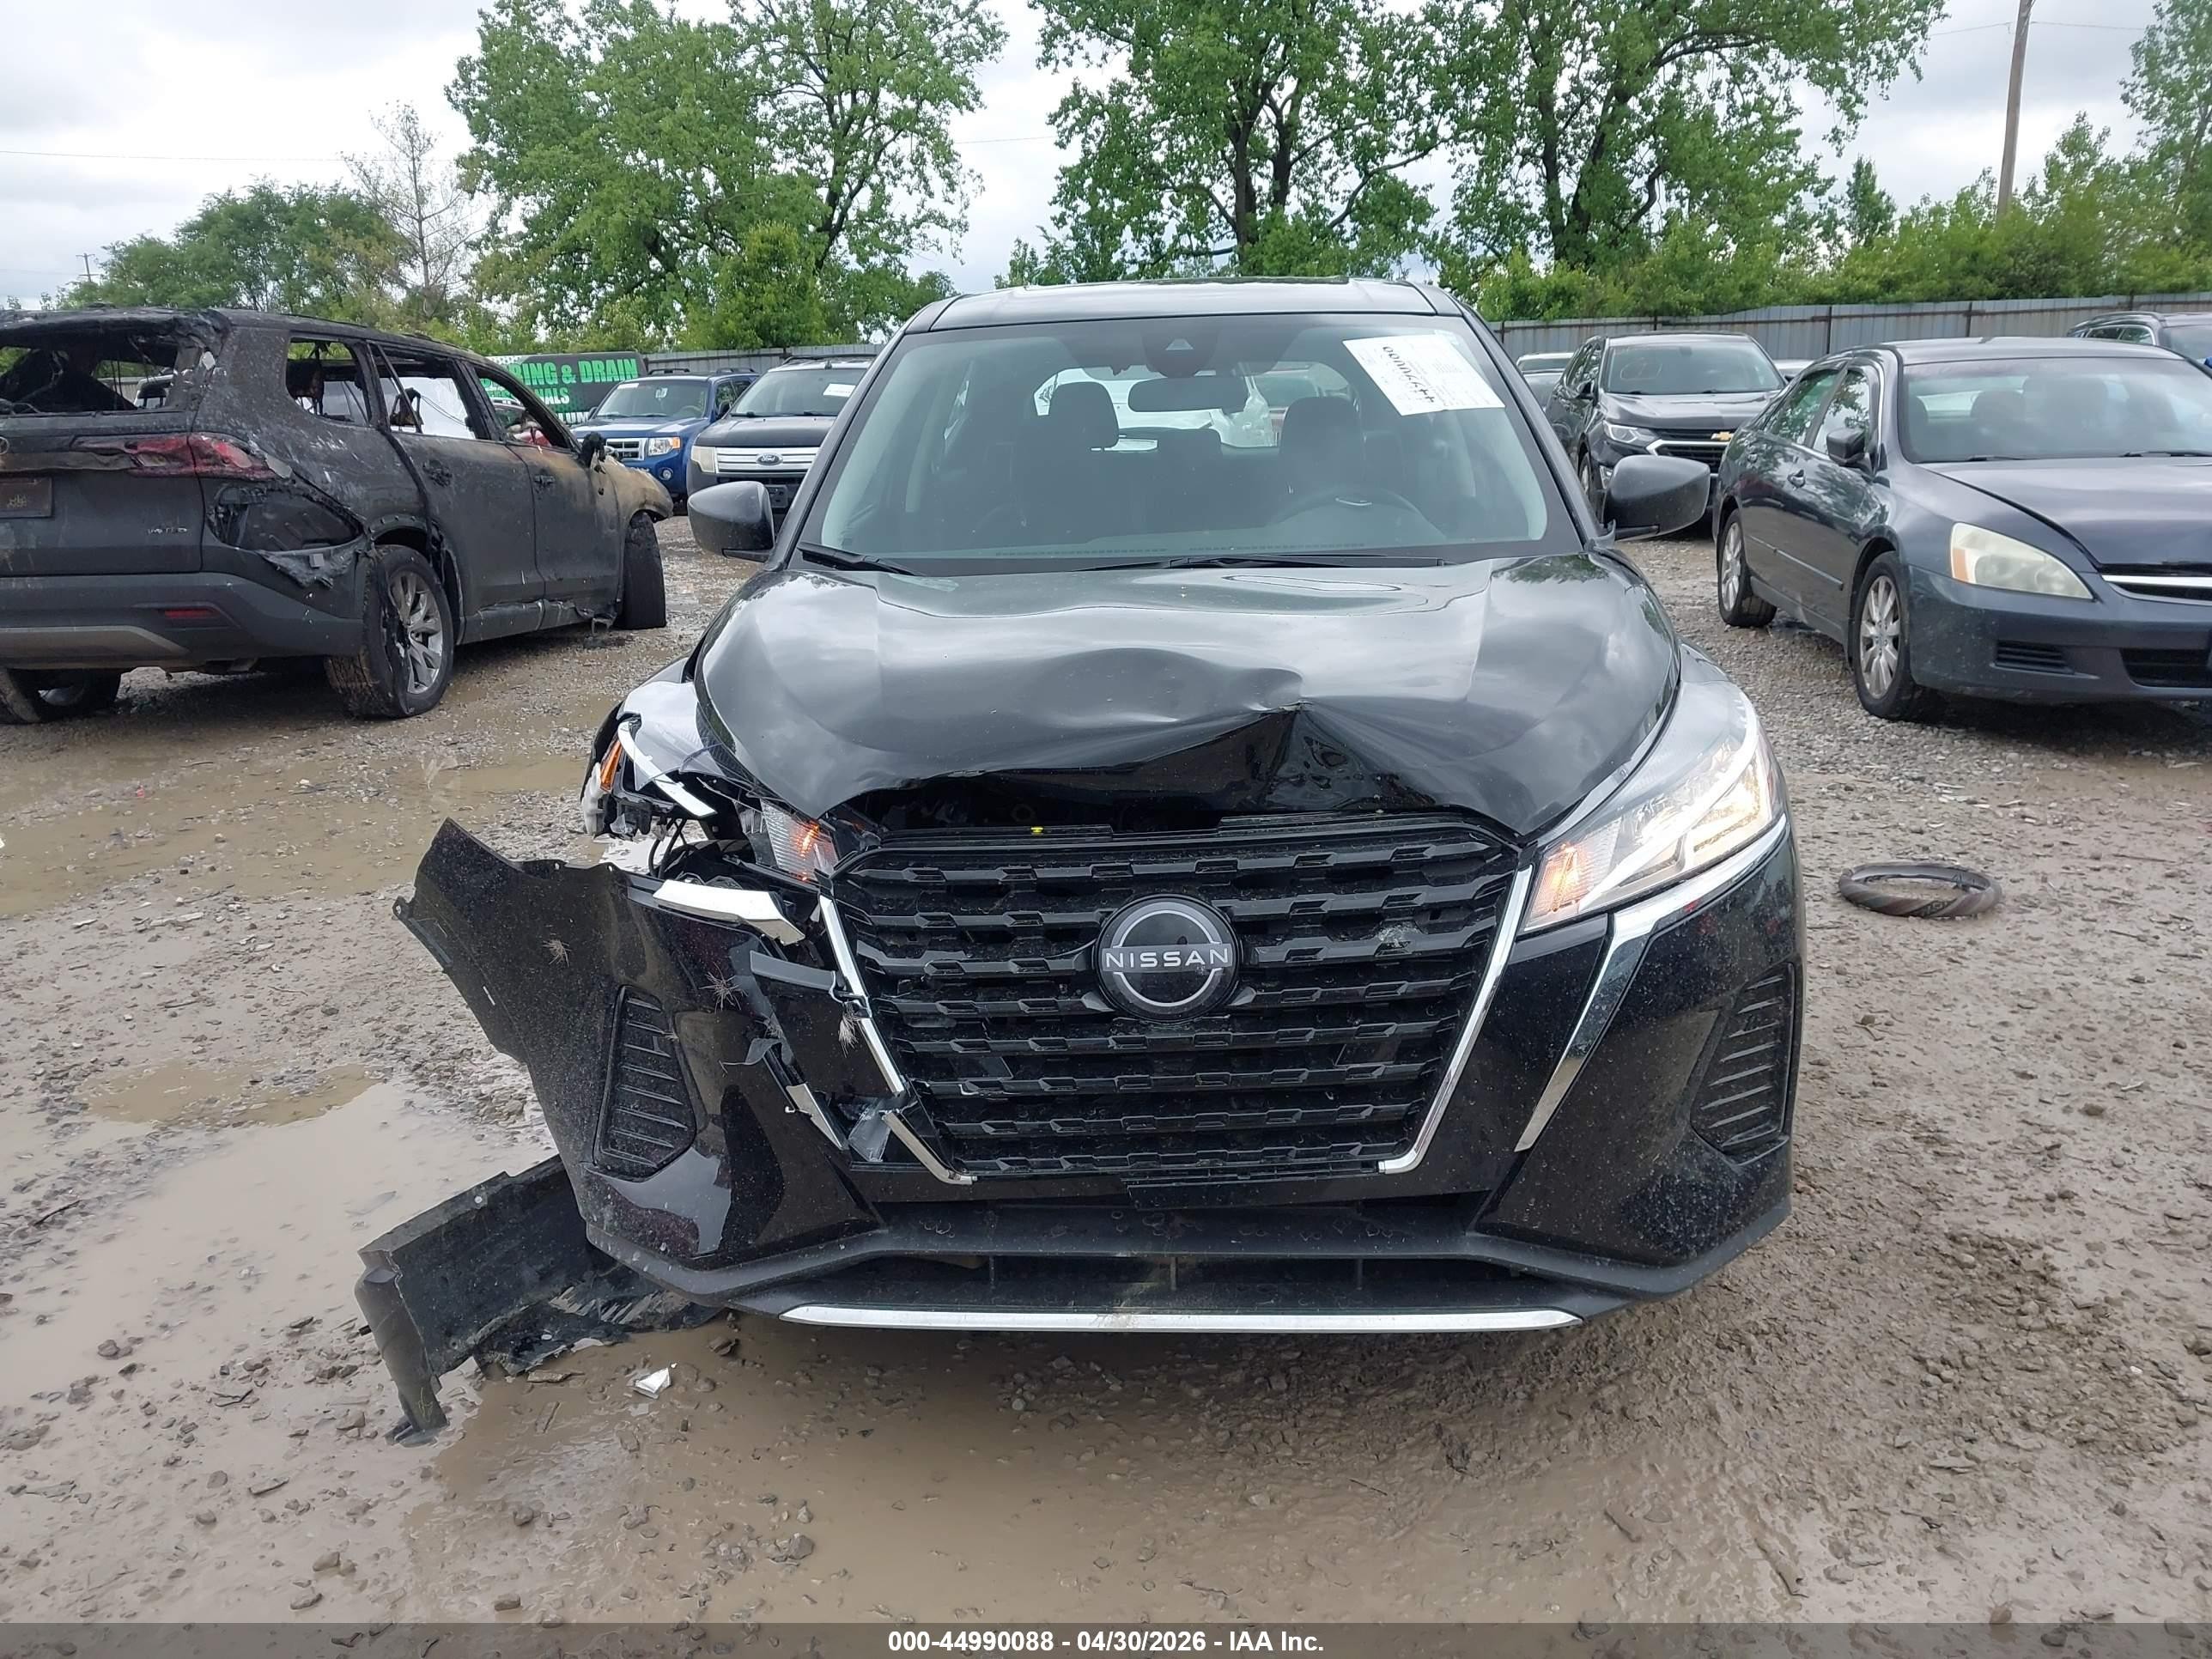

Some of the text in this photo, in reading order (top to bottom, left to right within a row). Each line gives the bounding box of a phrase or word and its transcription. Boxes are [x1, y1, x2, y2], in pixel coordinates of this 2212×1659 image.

[561, 364, 576, 384] &
[578, 358, 638, 383] DRAIN
[1105, 947, 1229, 969] NISSAN
